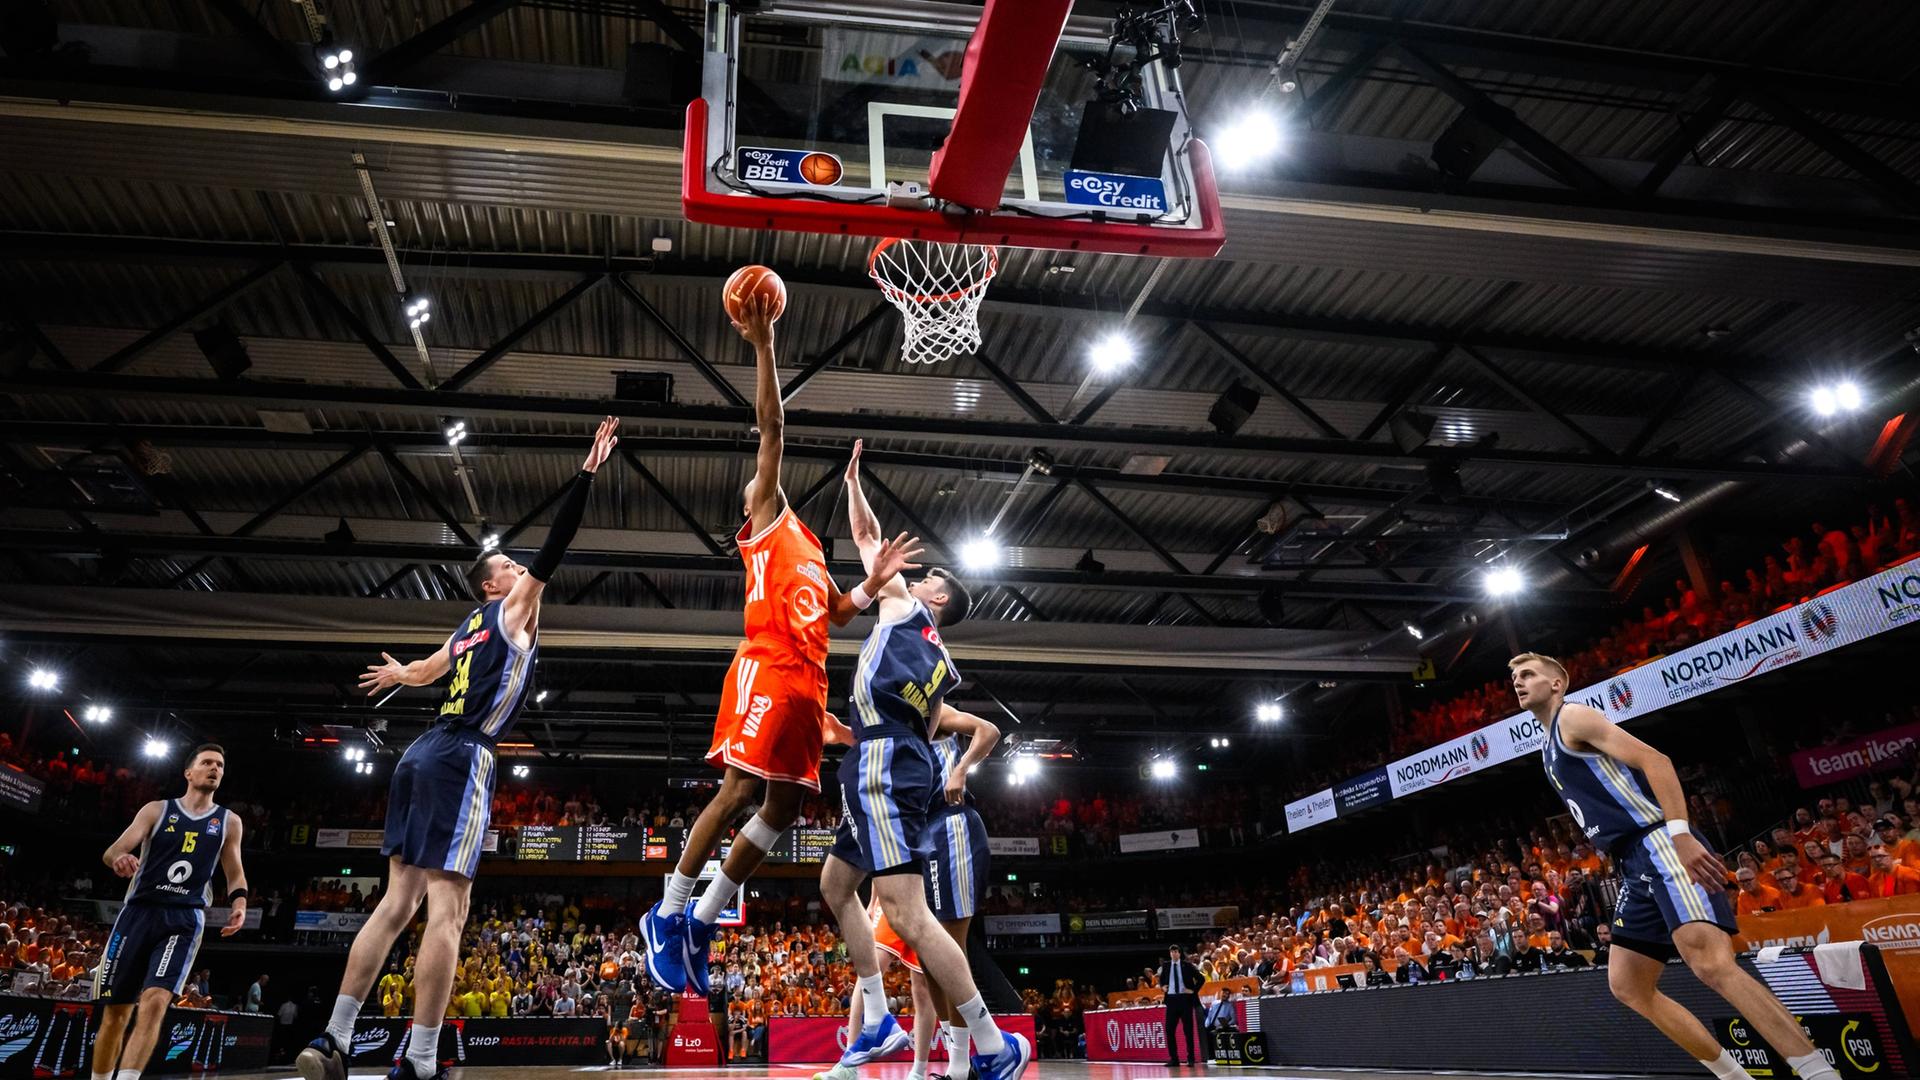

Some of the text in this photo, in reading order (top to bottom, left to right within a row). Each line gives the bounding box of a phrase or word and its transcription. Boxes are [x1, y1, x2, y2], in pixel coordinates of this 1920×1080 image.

[758, 159, 790, 167] Credit
[745, 165, 789, 181] BBL
[1098, 191, 1161, 209] Credit
[1661, 622, 1797, 688] NORDMANN
[923, 659, 948, 698] 9
[1668, 675, 1716, 700] GETRÄNKE
[1396, 744, 1469, 784] NORDMANN
[181, 831, 199, 853] 15
[468, 1036, 500, 1046] SHOP
[1733, 1027, 1747, 1039] PSR
[1848, 1038, 1875, 1057] PSR
[1746, 1048, 1769, 1066] PRO
